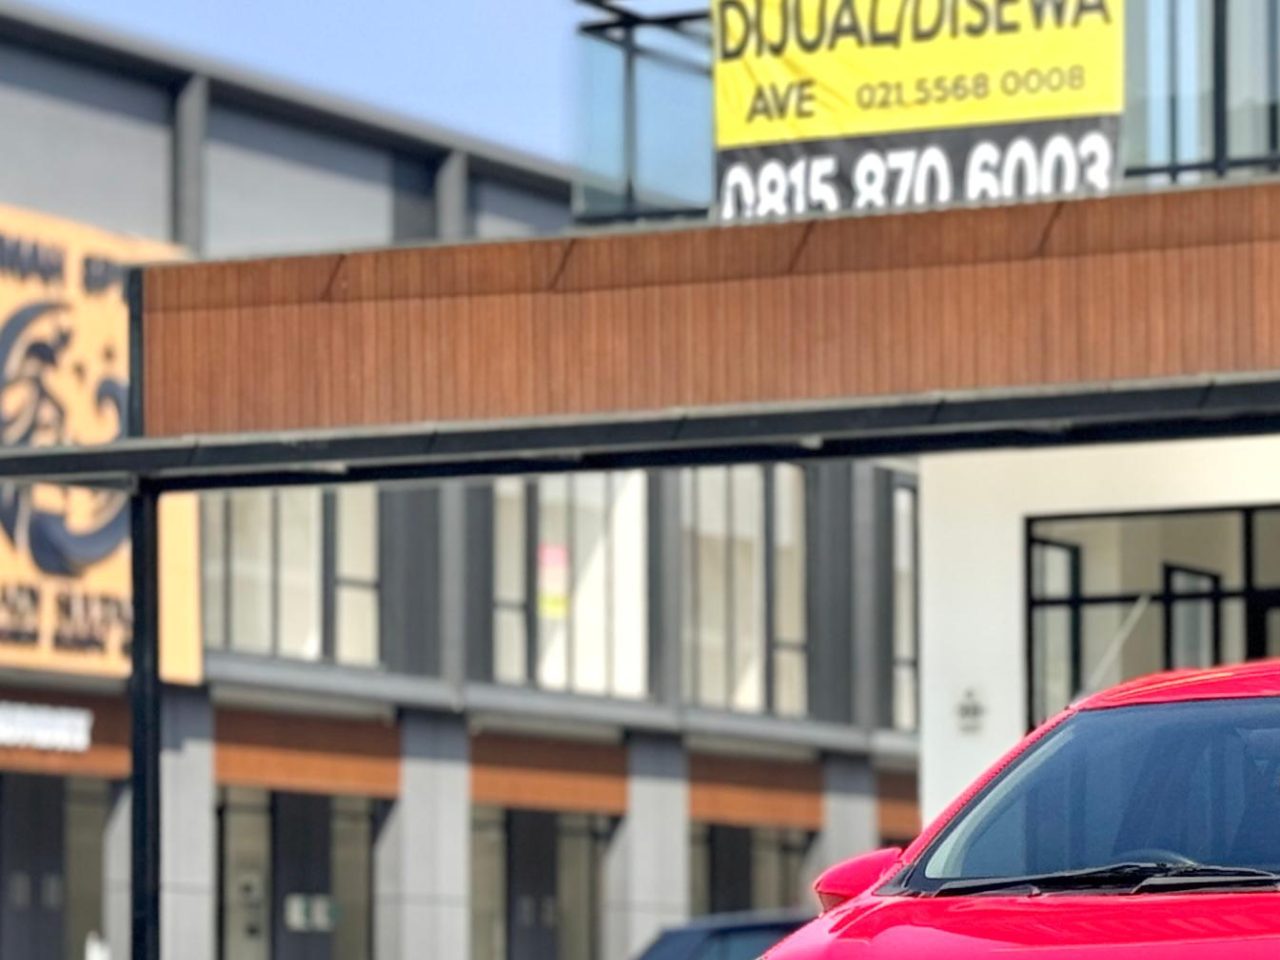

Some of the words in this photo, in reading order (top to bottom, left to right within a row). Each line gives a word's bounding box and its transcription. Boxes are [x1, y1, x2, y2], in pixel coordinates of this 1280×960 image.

[745, 77, 817, 124] AVE
[1000, 64, 1085, 96] 0008
[721, 156, 840, 220] 0815
[854, 144, 953, 209] 870
